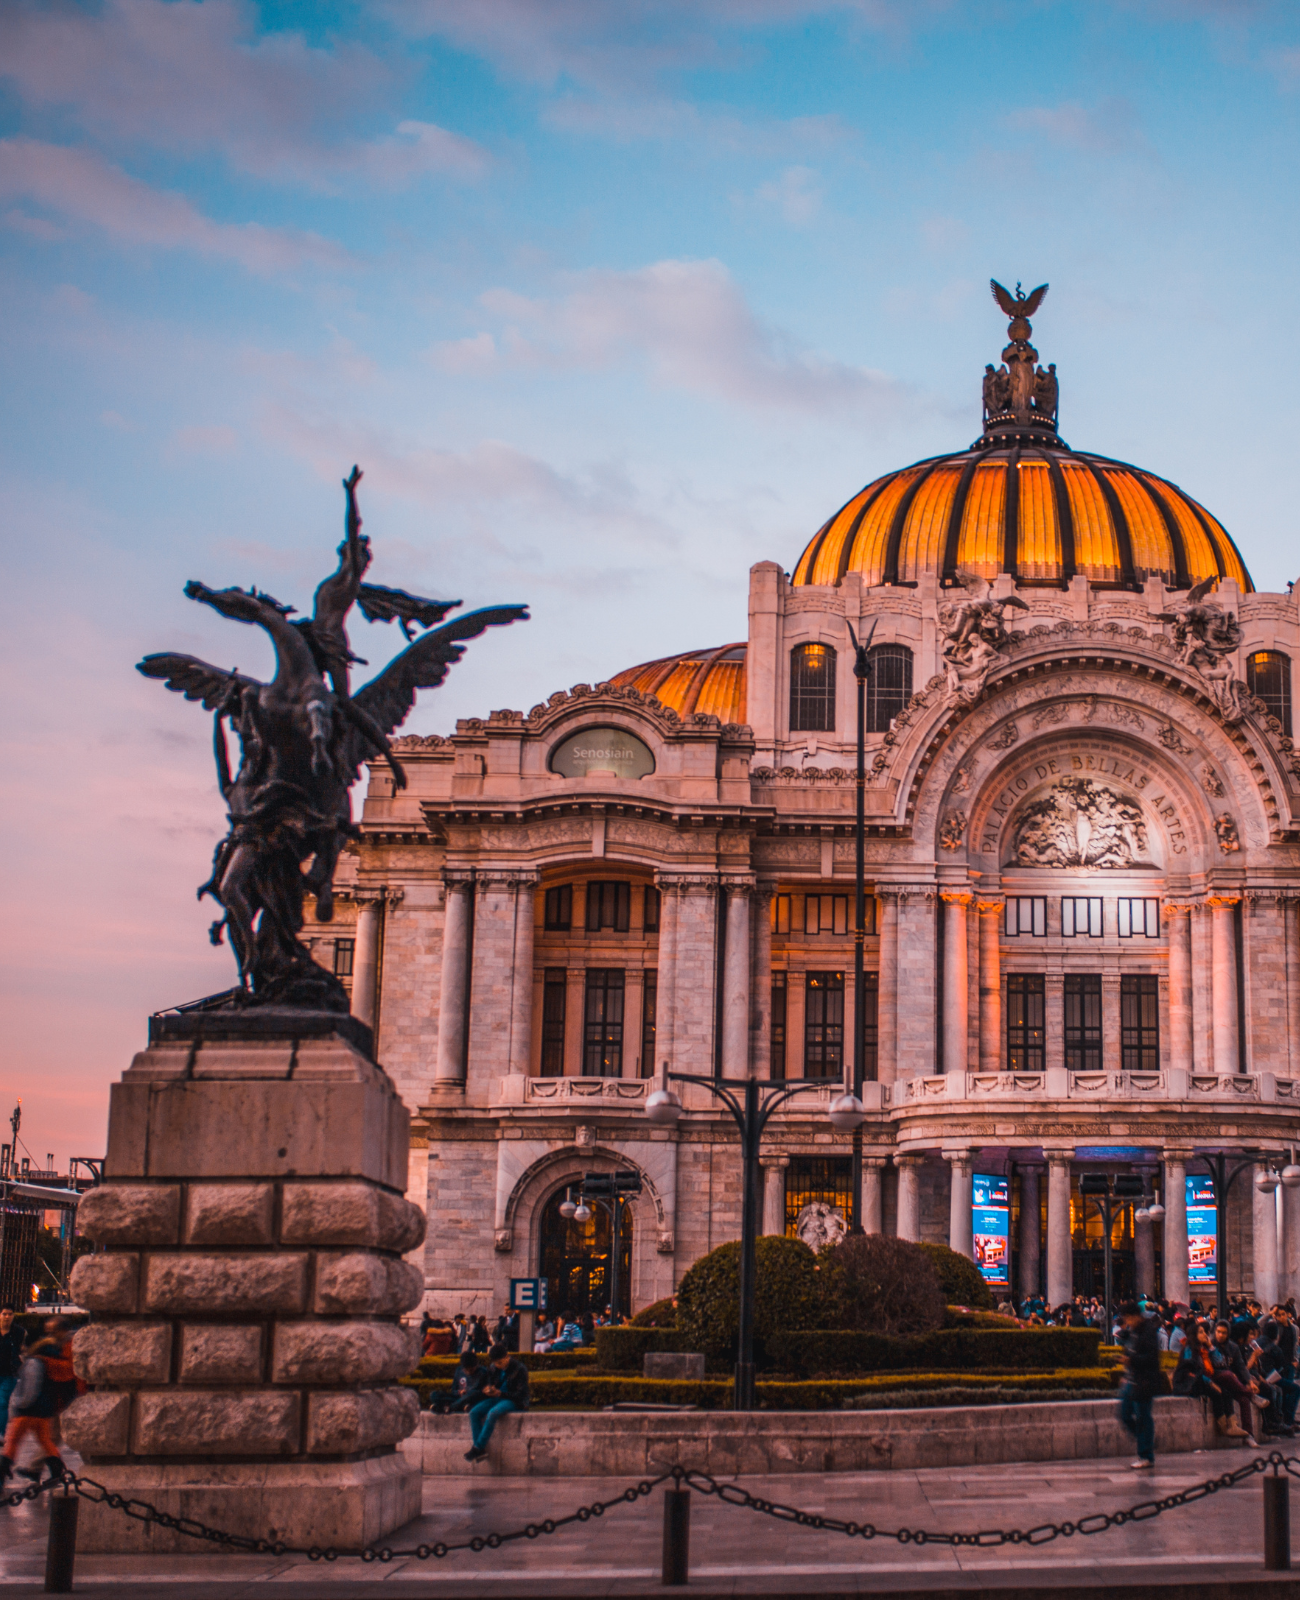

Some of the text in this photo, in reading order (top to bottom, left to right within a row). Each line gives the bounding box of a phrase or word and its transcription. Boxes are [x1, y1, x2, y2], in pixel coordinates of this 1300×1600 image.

[573, 747, 634, 758] Senosiain
[982, 755, 1187, 855] PALACIO DE BELLAS ARTES
[515, 1283, 534, 1305] E
